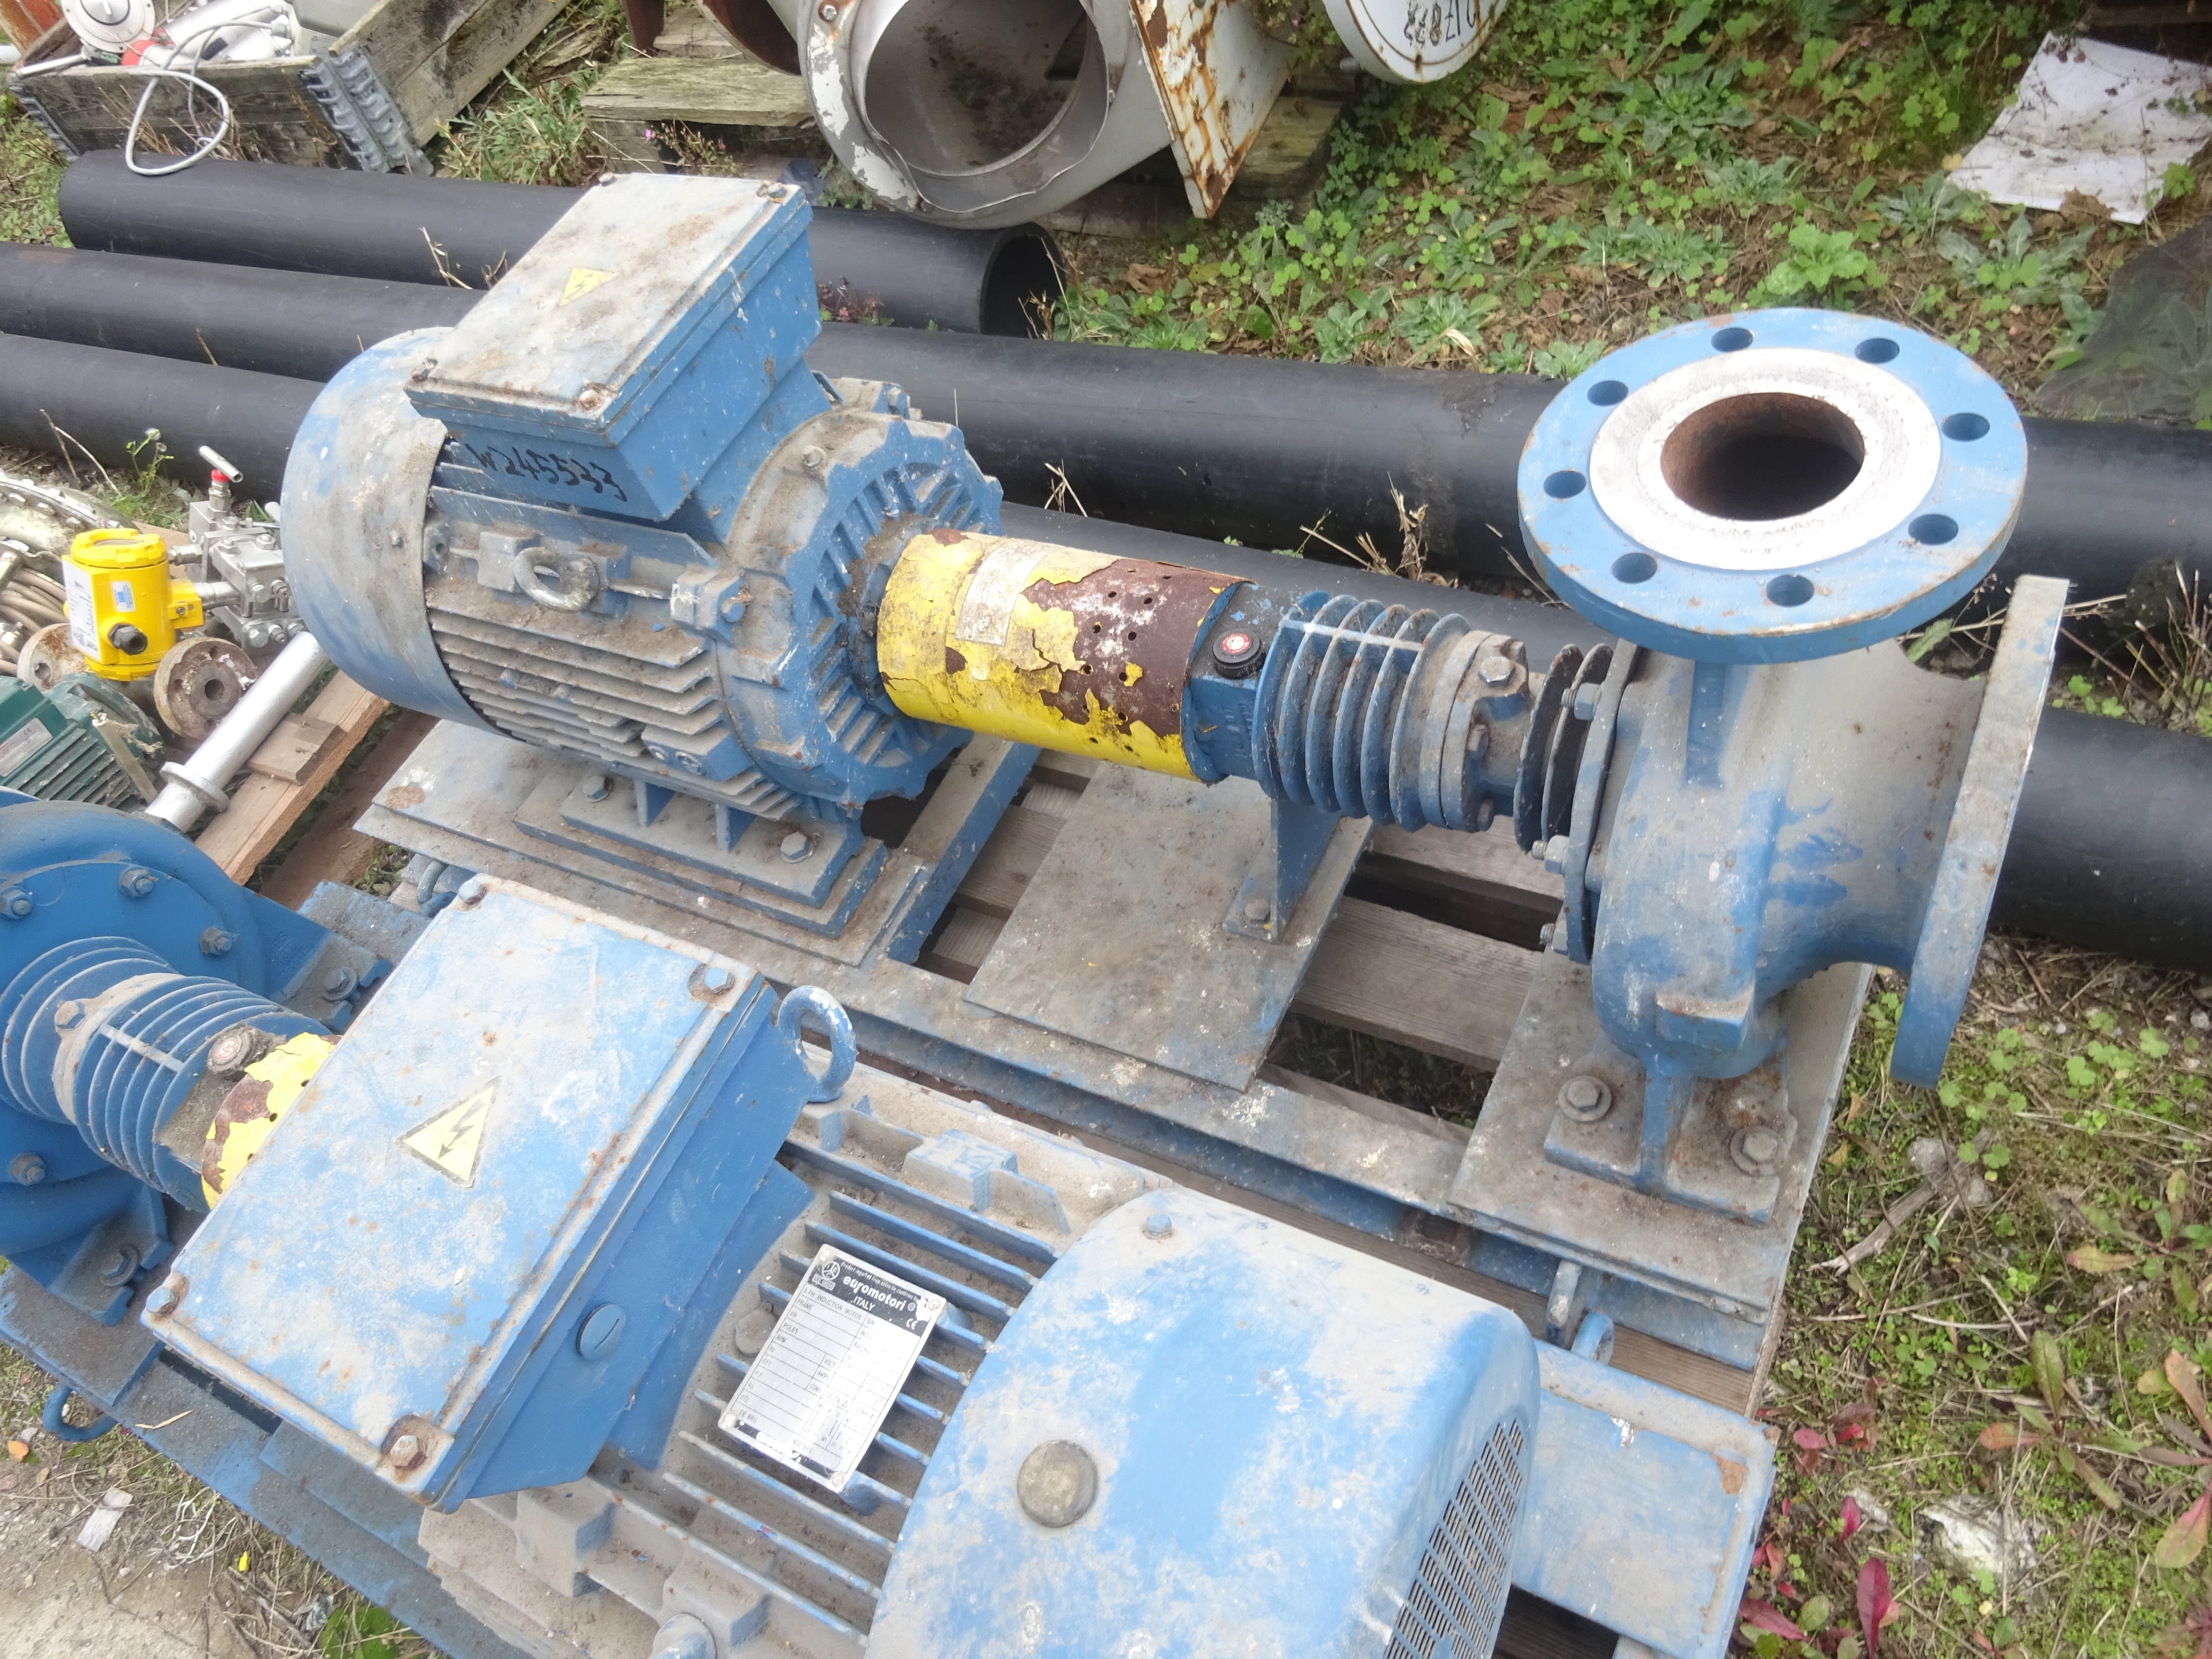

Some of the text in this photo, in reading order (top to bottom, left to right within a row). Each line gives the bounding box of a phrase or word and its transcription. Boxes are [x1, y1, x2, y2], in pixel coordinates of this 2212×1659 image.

[841, 1273, 908, 1312] euromotori
[796, 1298, 814, 1311] FRAME
[816, 1294, 844, 1311] INDUCTION
[844, 1307, 862, 1320] MOTOR
[853, 1295, 876, 1312] ITALY
[866, 1317, 876, 1326] S/N
[775, 1334, 787, 1343] RPM
[823, 1358, 837, 1368] VOLTS
[816, 1370, 830, 1381] AMPS
[825, 1391, 842, 1404] DELTA
[738, 1409, 758, 1424] DE BRG
